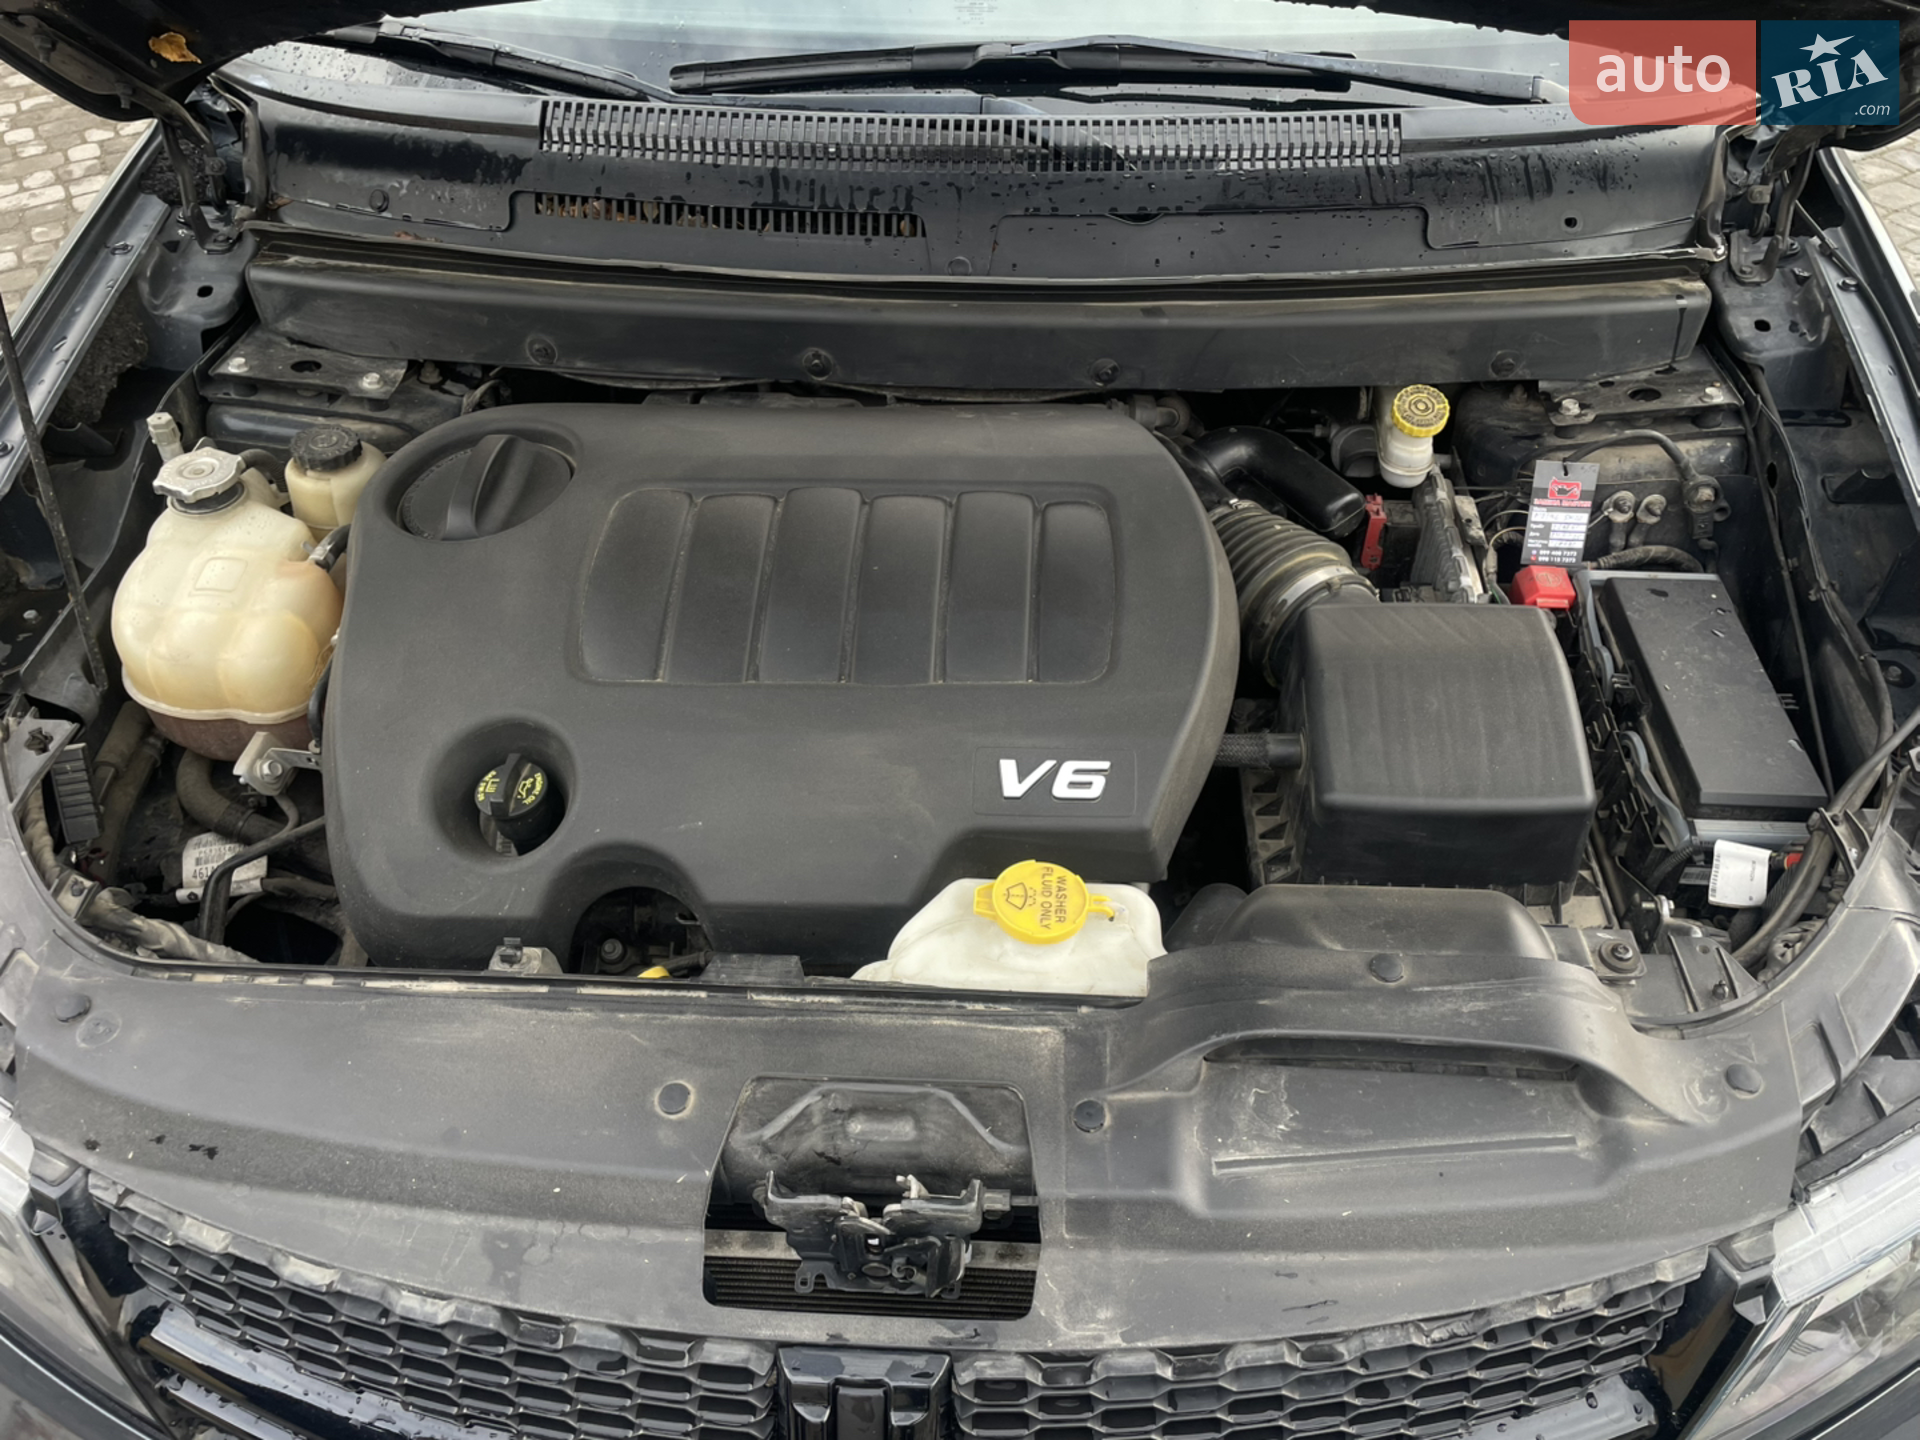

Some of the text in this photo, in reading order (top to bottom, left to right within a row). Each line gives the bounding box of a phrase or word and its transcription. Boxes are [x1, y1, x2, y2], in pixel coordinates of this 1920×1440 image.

[999, 759, 1111, 802] V6
[1040, 866, 1054, 931] FLUID ONLY
[1054, 875, 1068, 924] WASHER
